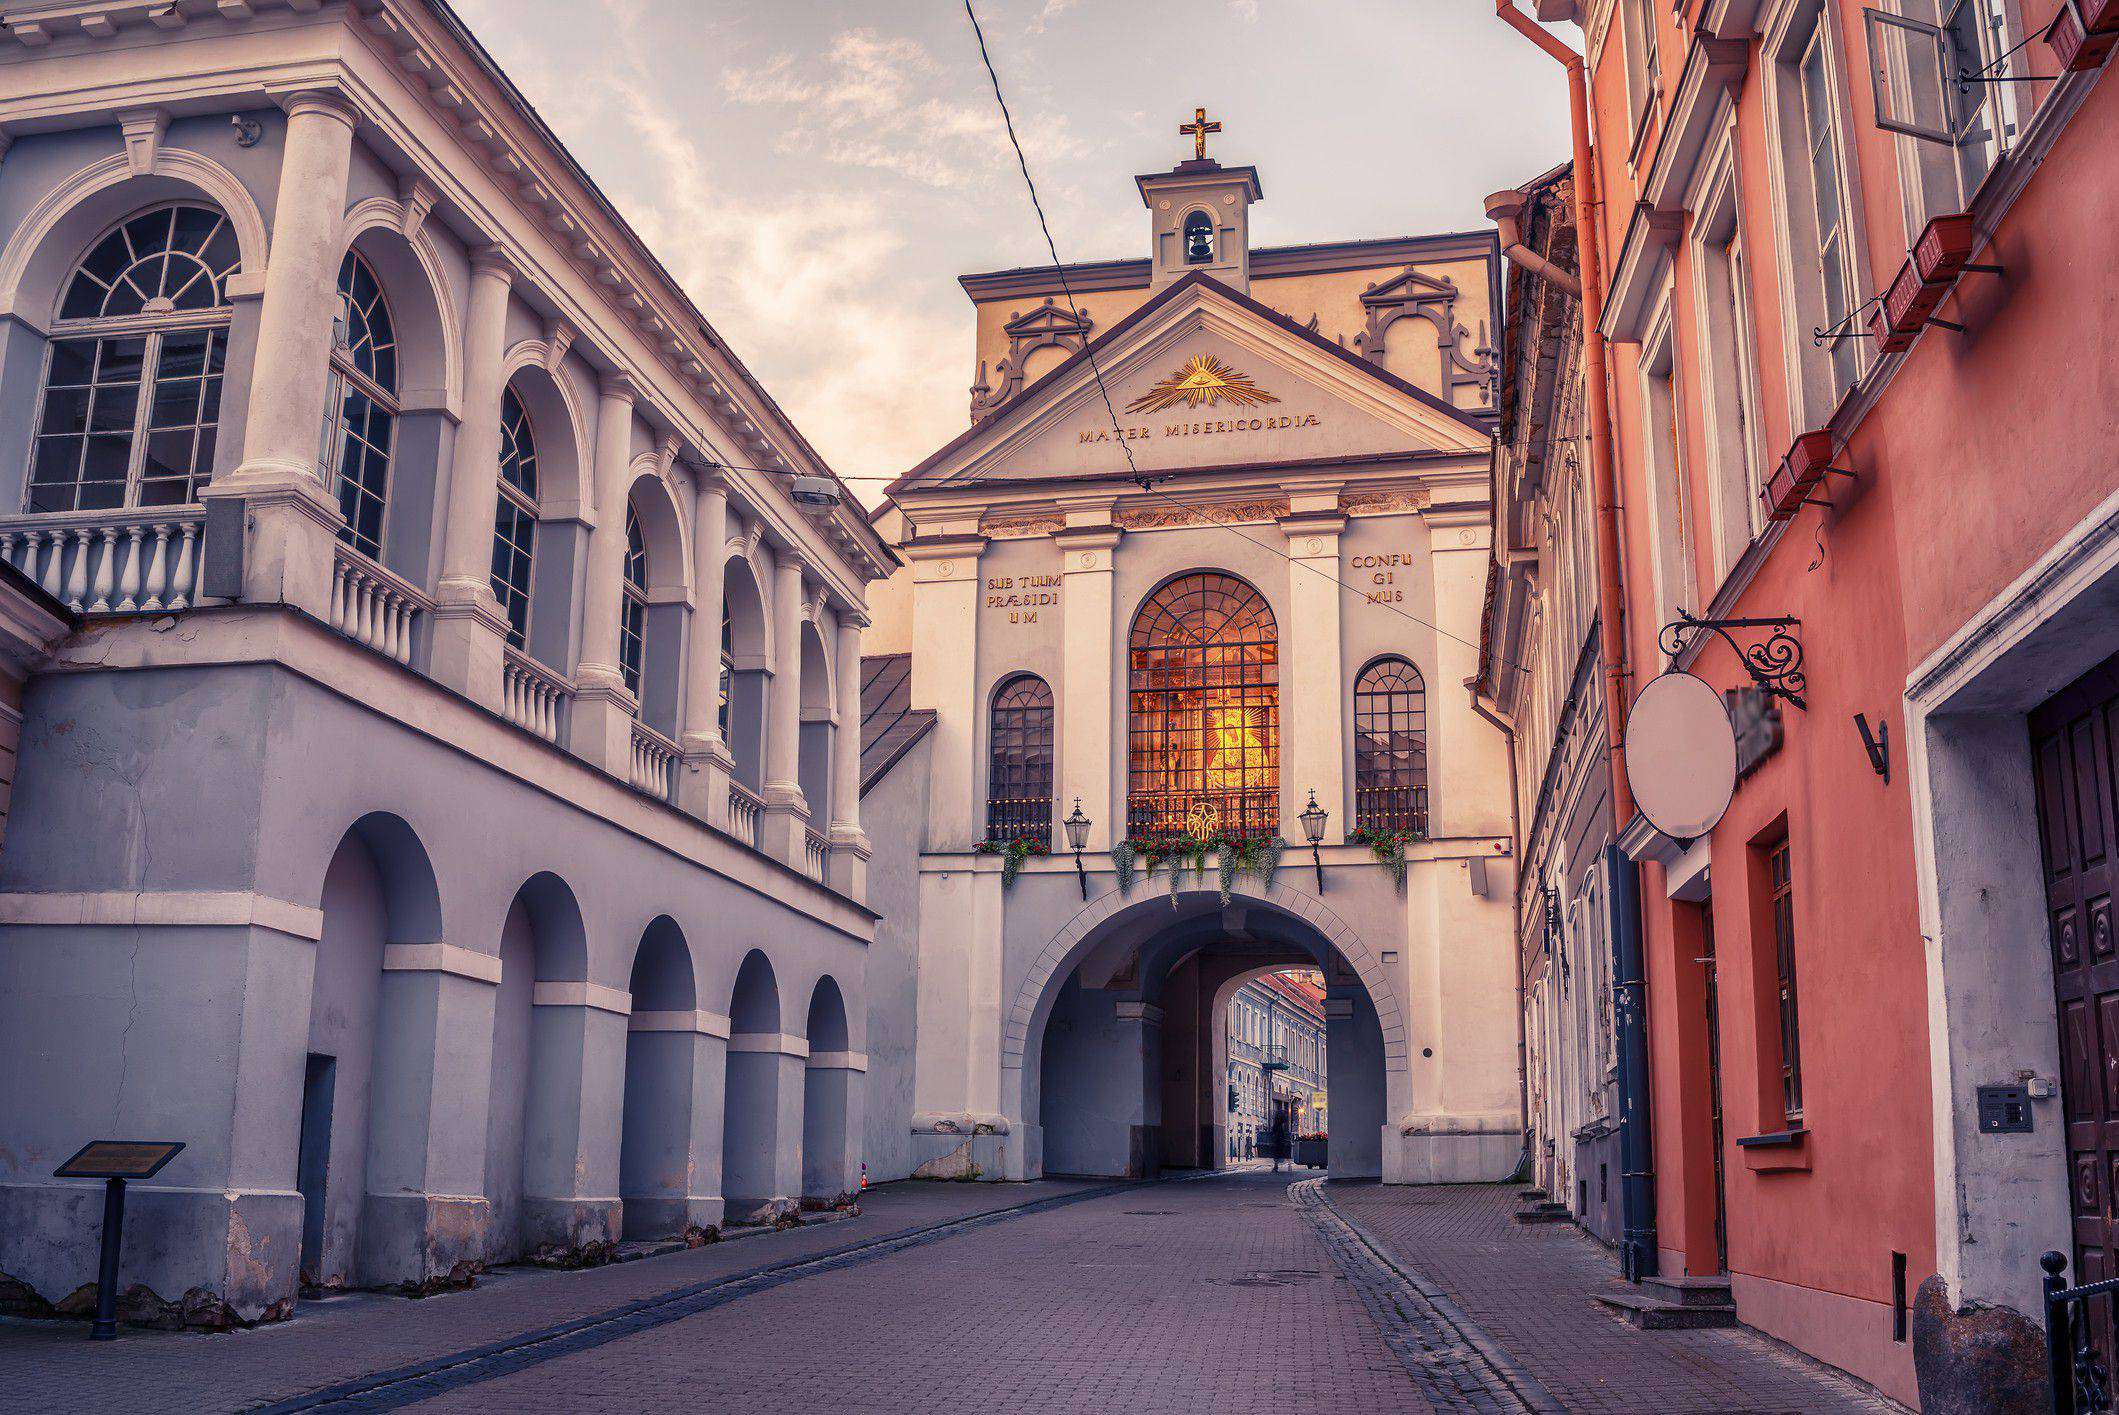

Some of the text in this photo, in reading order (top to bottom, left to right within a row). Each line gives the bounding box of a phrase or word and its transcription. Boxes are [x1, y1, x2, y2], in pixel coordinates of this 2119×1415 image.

[1079, 426, 1150, 443] MATER
[1351, 553, 1412, 568] CONFU
[988, 574, 1062, 590] SUB TUUM
[1373, 571, 1393, 585] GI
